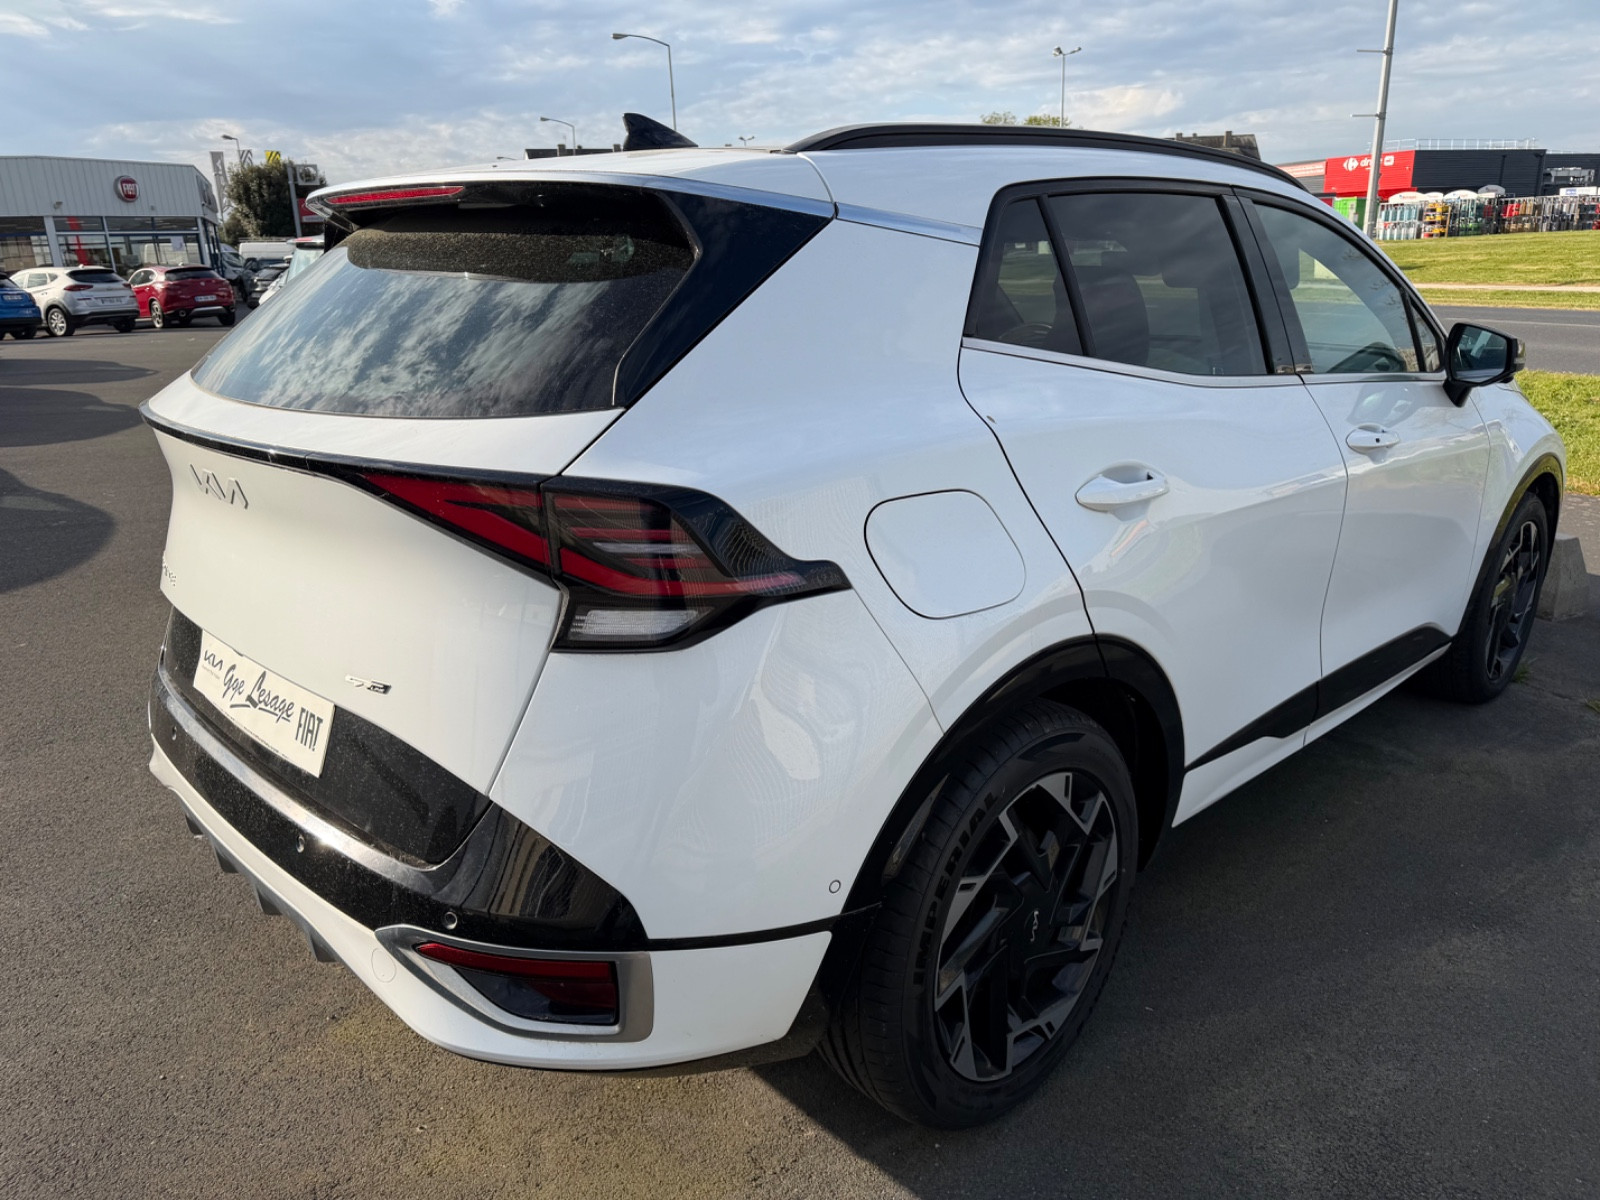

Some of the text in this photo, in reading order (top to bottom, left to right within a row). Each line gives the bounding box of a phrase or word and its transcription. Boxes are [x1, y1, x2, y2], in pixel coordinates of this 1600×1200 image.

[122, 183, 139, 196] FIAT
[245, 670, 295, 723] Lesage
[295, 707, 324, 752] FIAT
